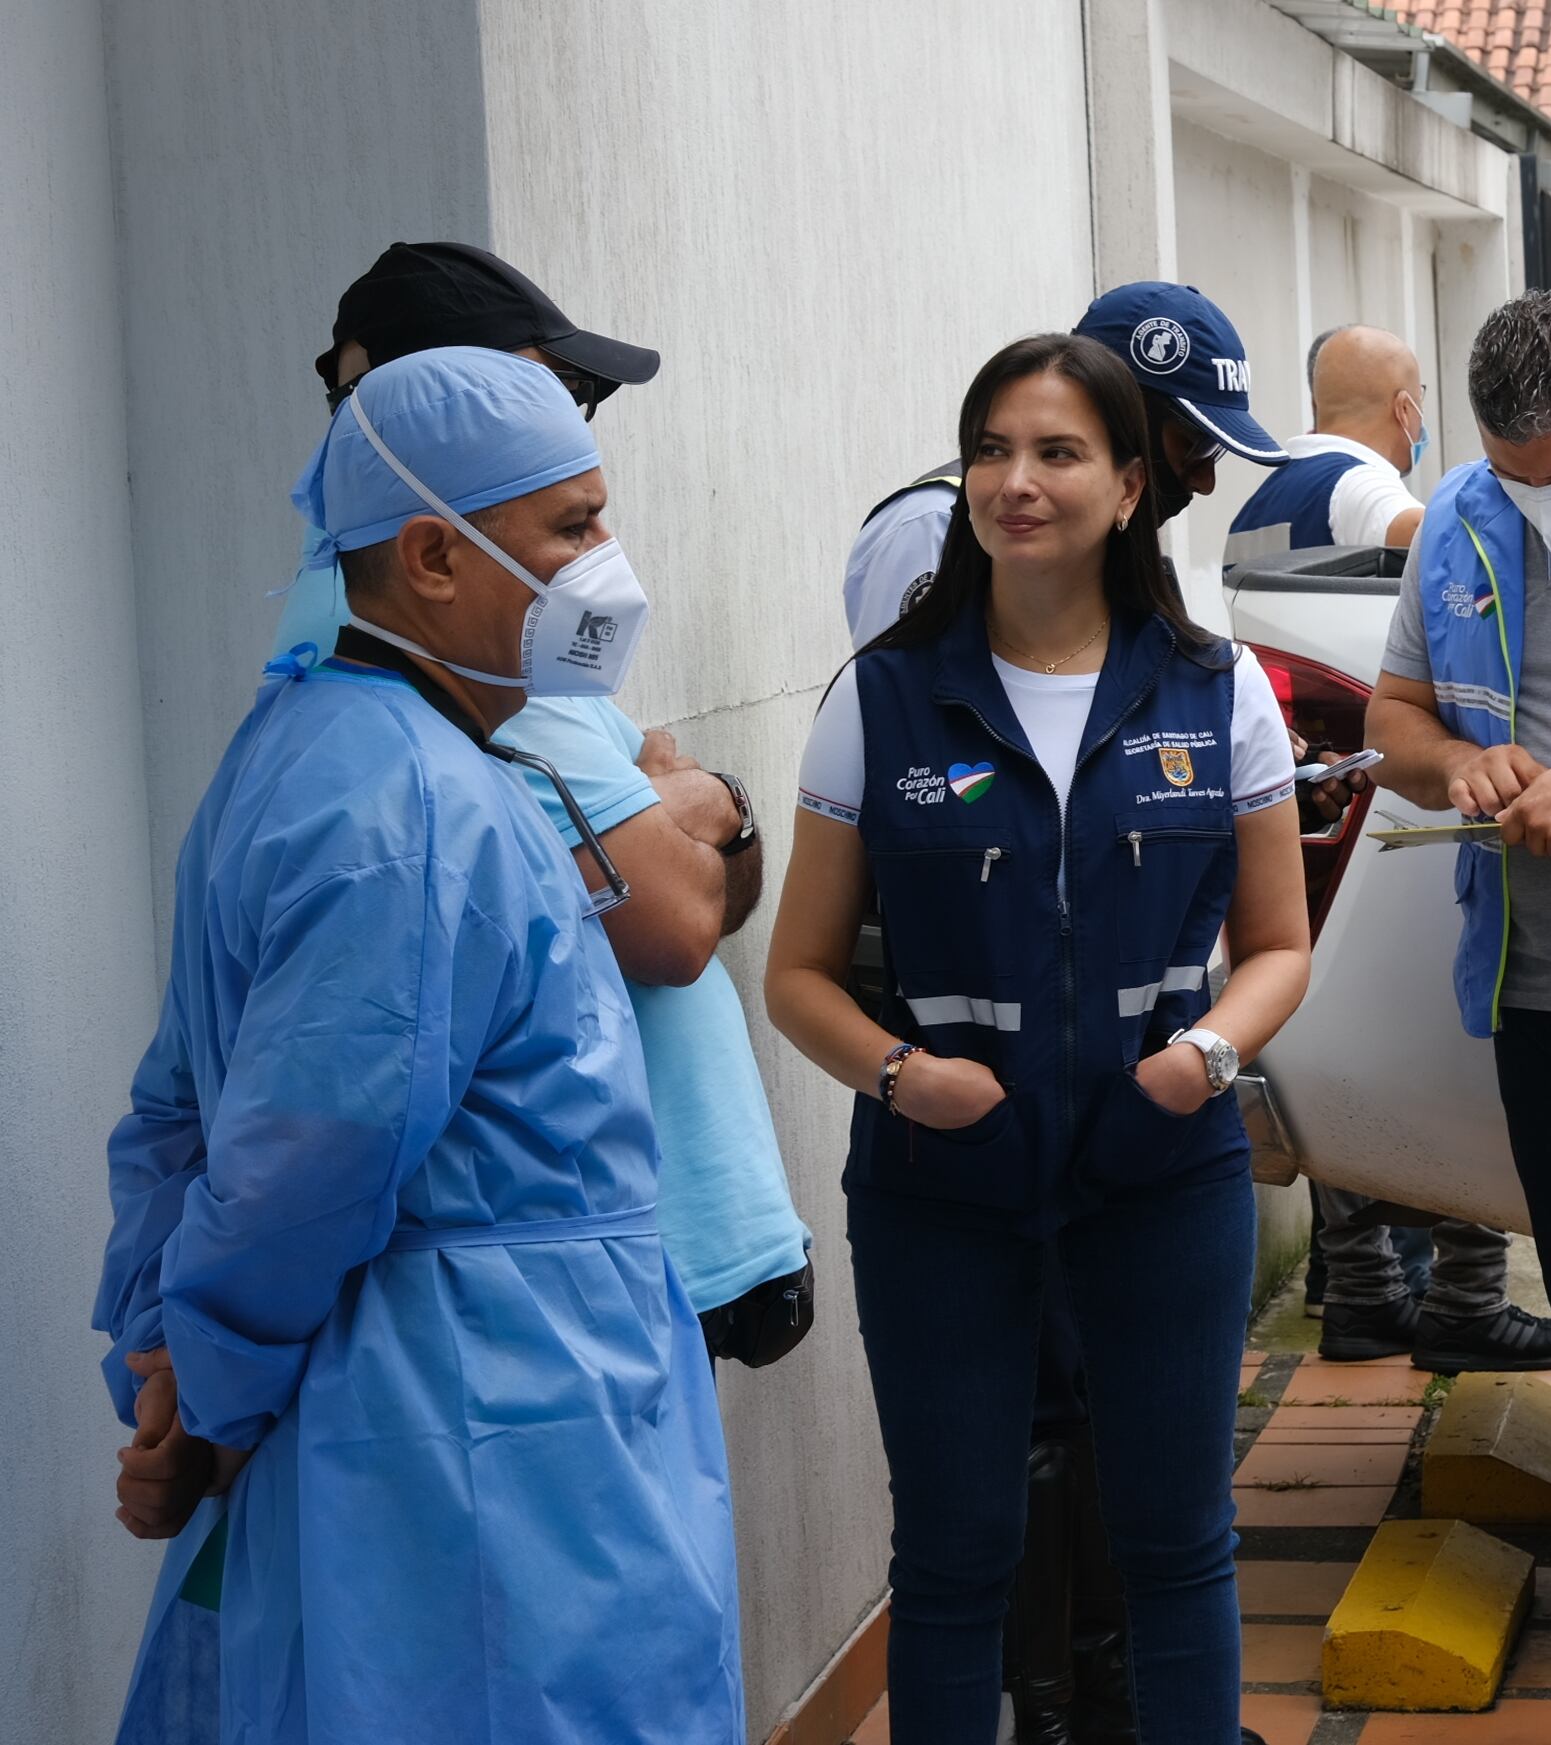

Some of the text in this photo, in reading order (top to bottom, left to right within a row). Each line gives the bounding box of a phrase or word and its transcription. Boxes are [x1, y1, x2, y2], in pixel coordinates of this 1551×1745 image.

[908, 766, 931, 778] Puro
[896, 774, 945, 790] Corazón
[917, 787, 946, 805] Cali
